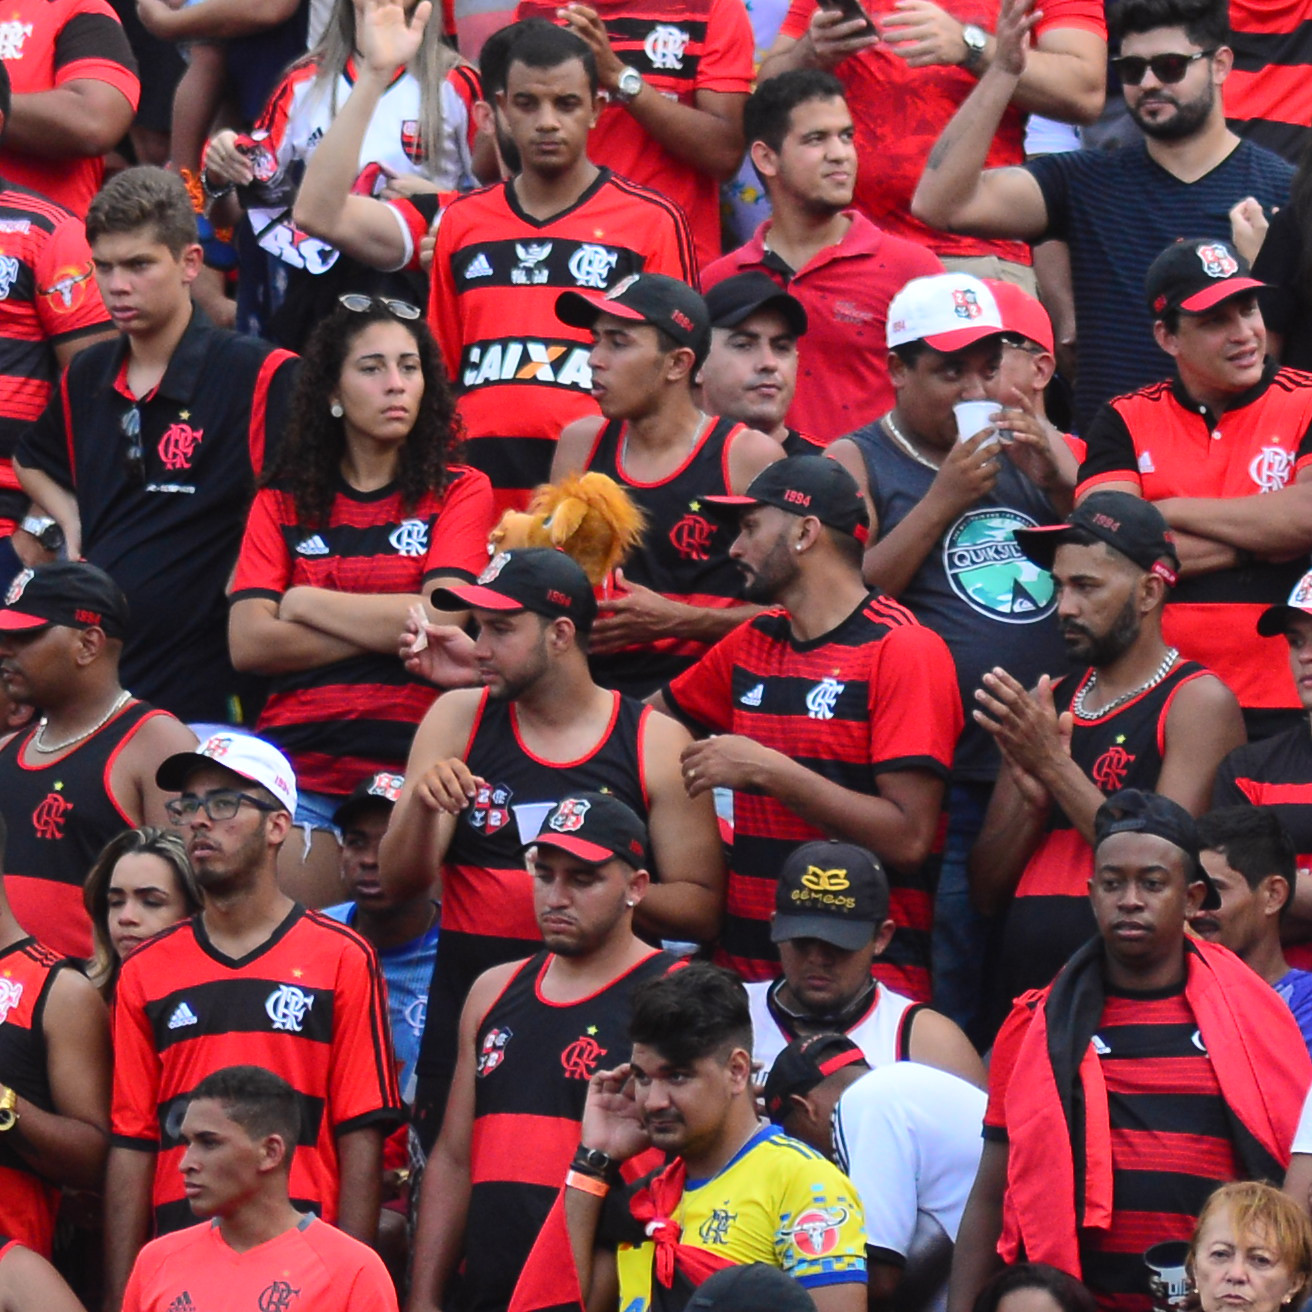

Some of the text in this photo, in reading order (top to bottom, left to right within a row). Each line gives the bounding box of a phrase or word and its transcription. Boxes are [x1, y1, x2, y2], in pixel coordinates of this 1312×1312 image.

[462, 342, 592, 390] CAIXA
[783, 489, 811, 508] 1994
[952, 542, 1022, 568] QUIKSIL
